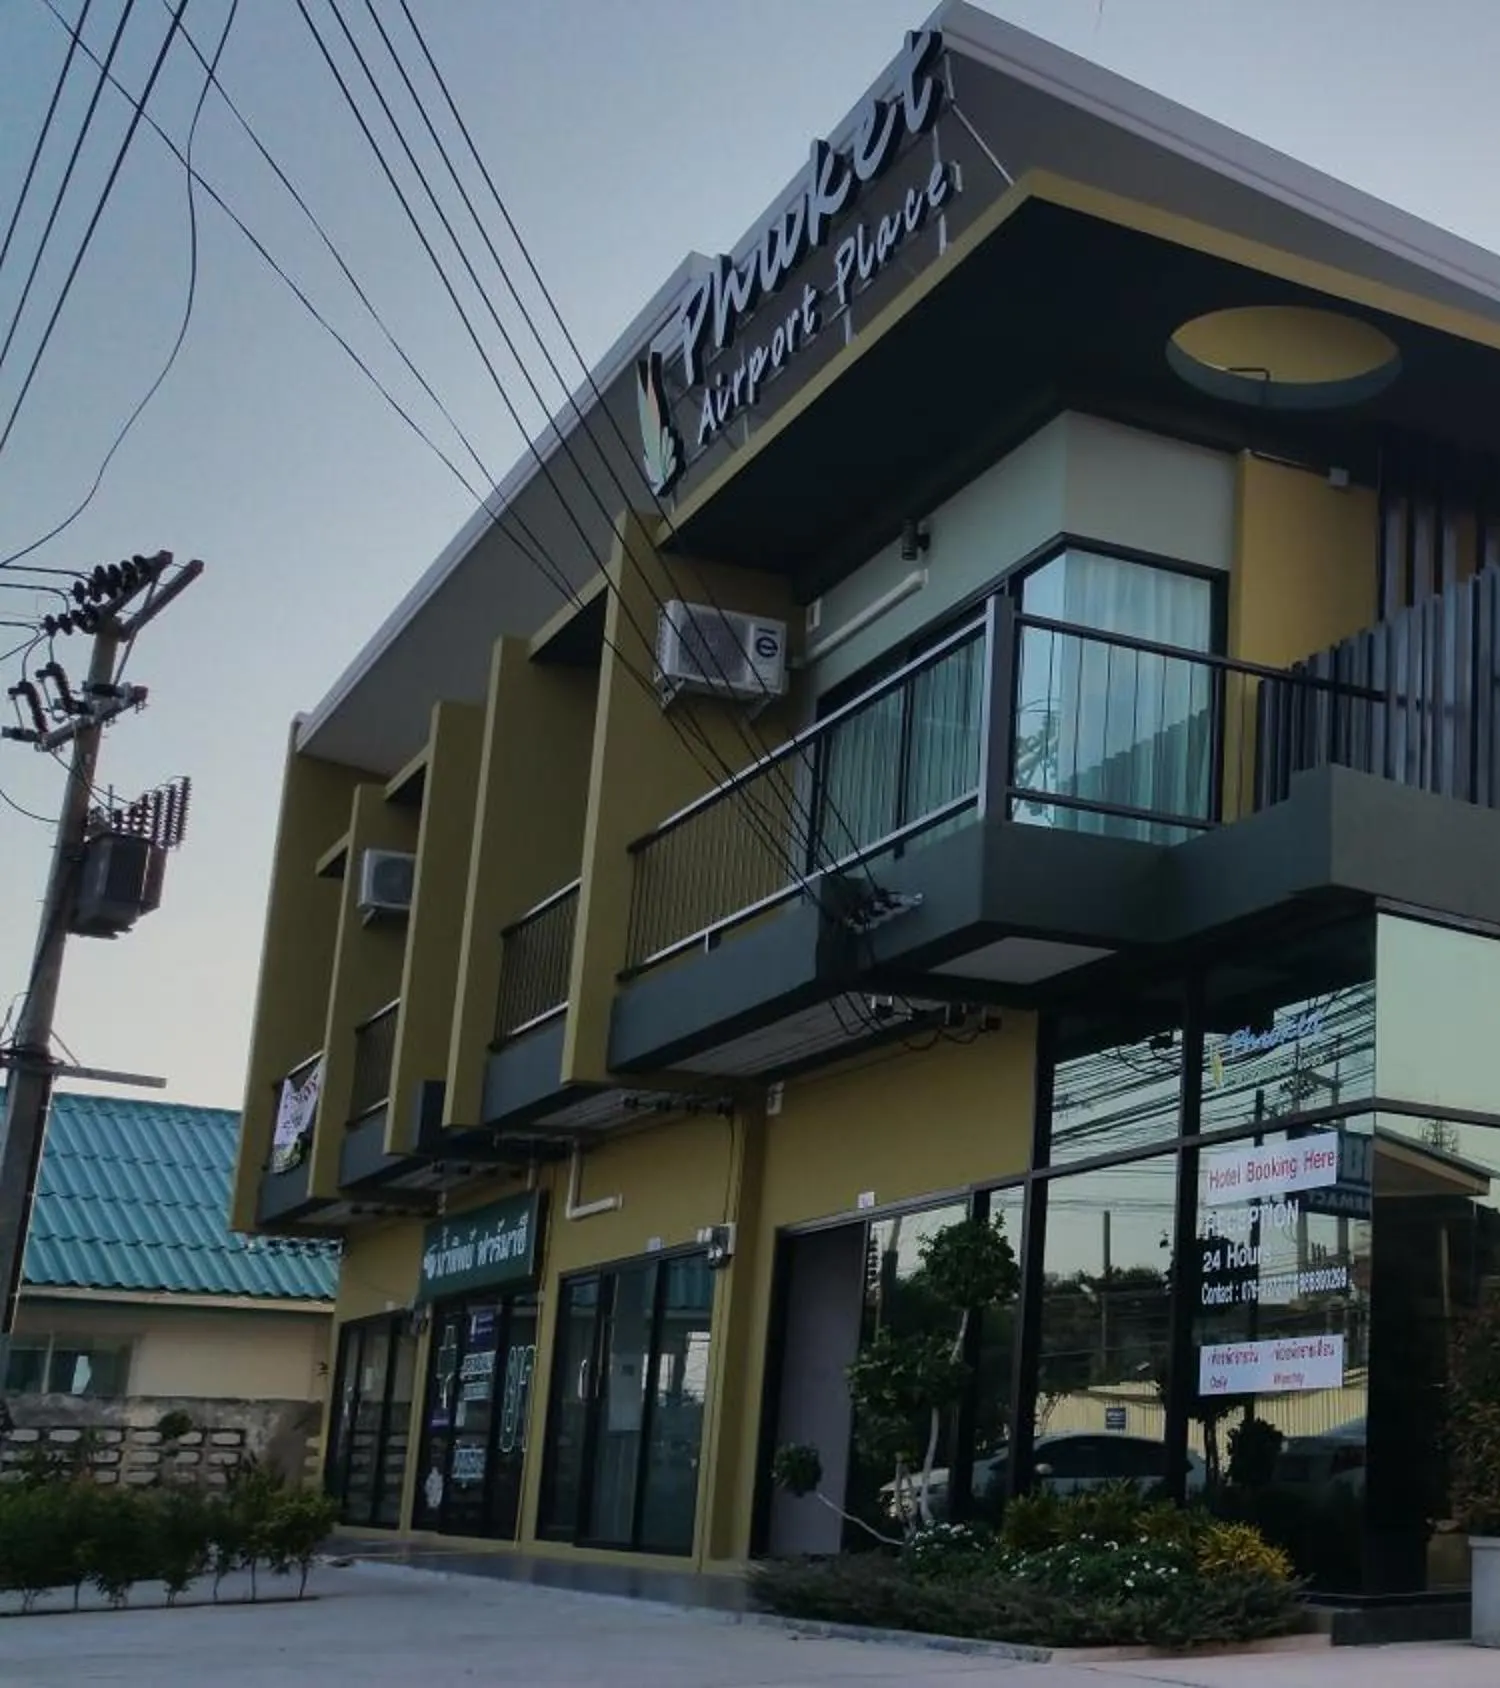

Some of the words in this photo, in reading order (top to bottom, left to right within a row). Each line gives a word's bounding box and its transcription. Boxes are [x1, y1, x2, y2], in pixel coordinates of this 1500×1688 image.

[674, 30, 943, 385] Phuket
[698, 283, 821, 447] Airport
[834, 160, 951, 304] Place
[1209, 1163, 1241, 1191] Hotel
[1246, 1154, 1297, 1182] Booking
[1304, 1147, 1335, 1173] Here
[1203, 1250, 1221, 1272] 24
[1227, 1243, 1271, 1269] Hours
[1202, 1282, 1232, 1305] Contact
